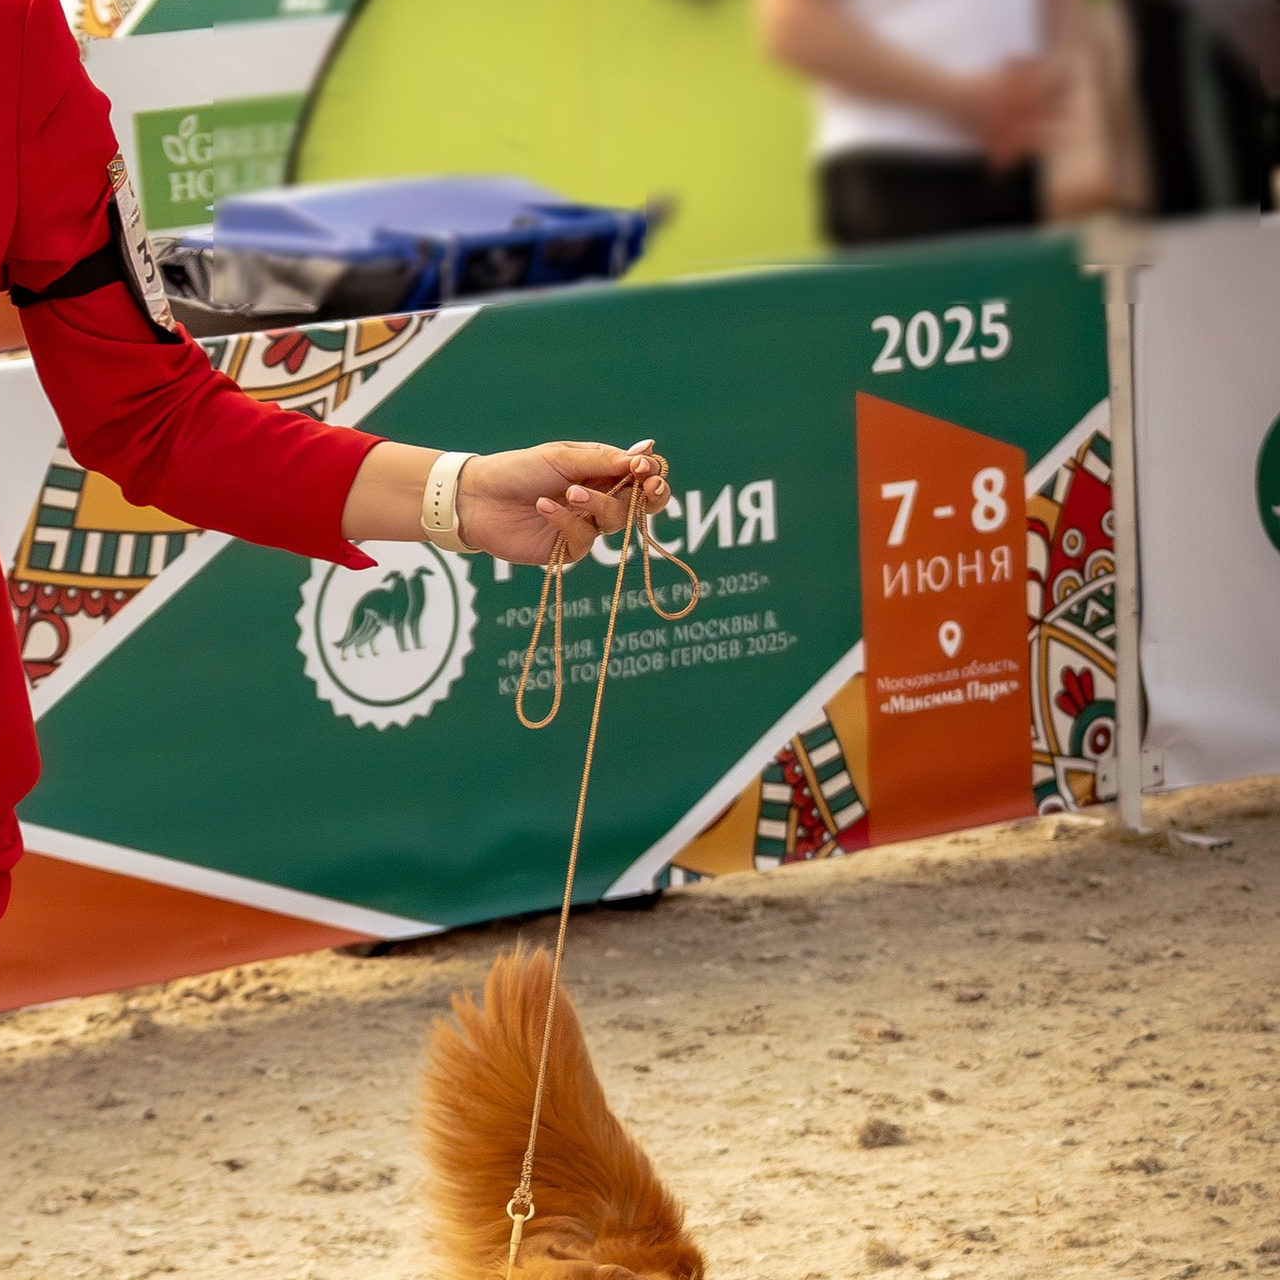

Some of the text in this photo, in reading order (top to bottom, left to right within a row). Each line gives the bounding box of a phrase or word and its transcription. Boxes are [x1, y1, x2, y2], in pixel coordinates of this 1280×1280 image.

[871, 303, 1011, 373] 2025
[880, 479, 919, 547] 7
[972, 466, 1008, 534] 8
[882, 545, 1011, 599] ИЮНЯ
